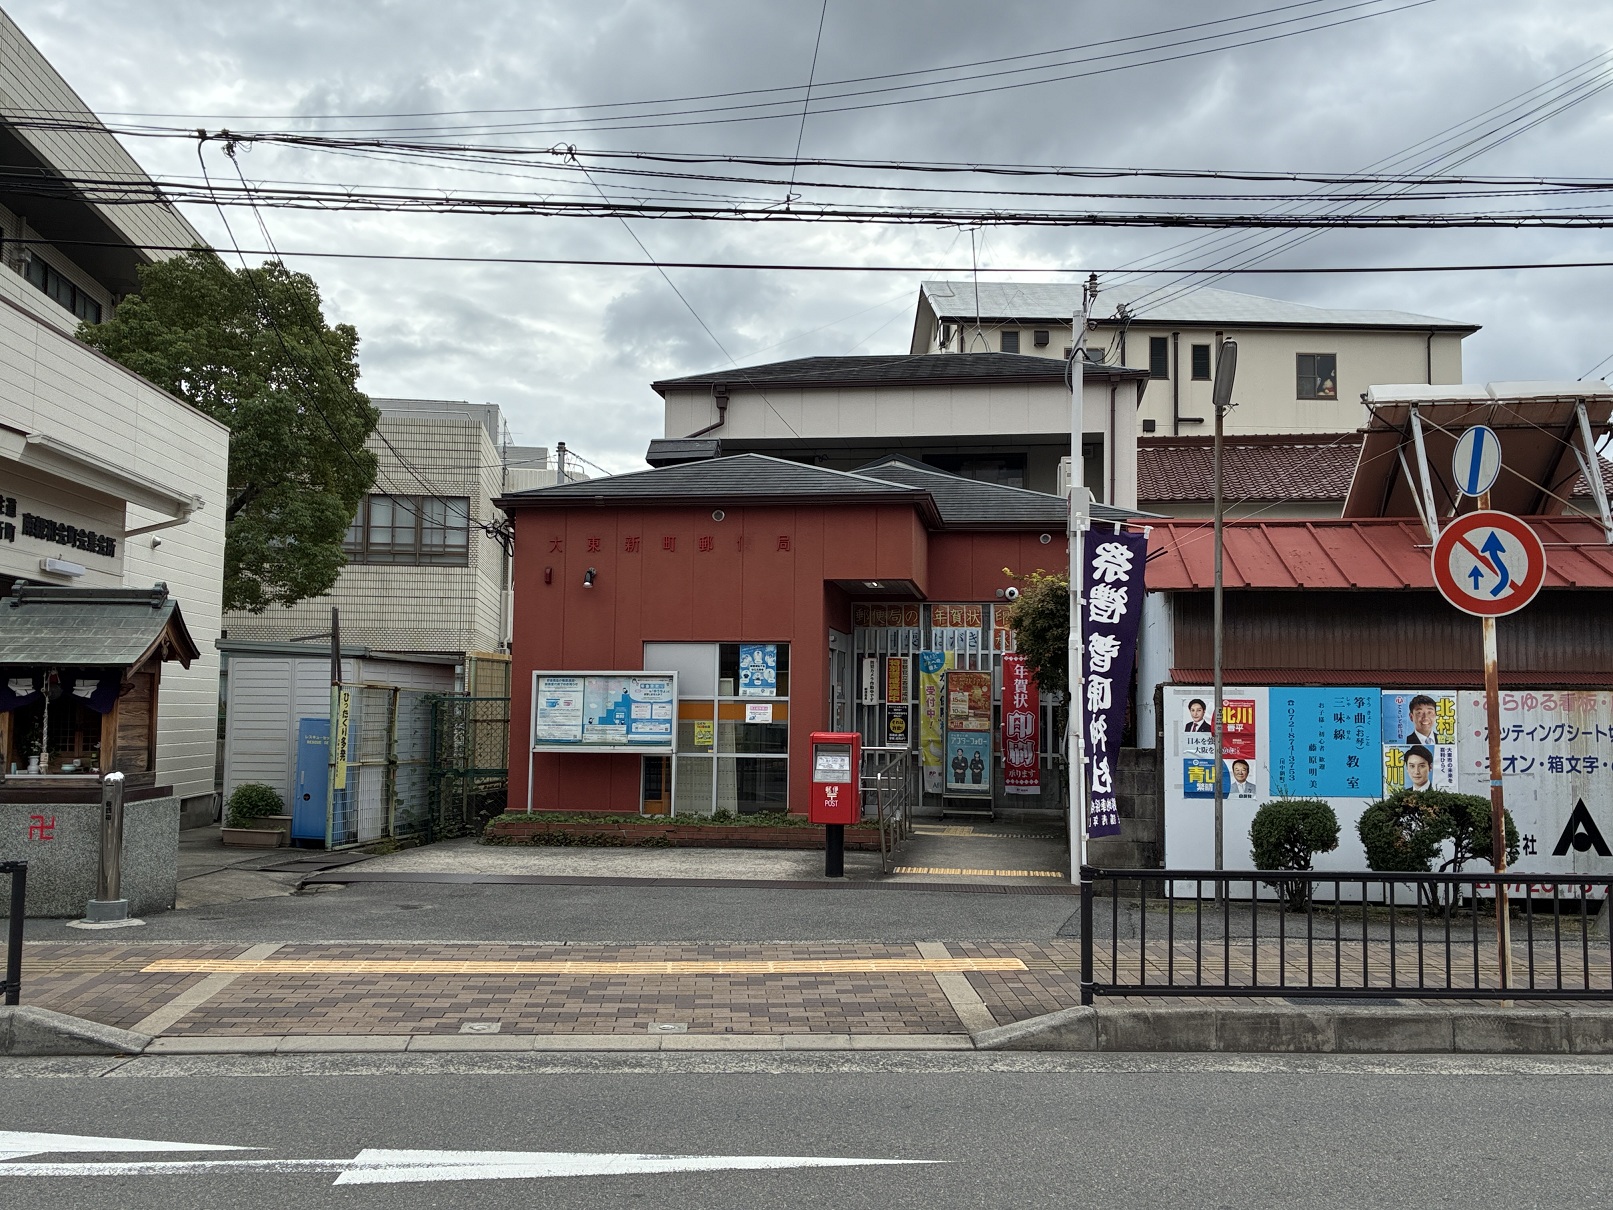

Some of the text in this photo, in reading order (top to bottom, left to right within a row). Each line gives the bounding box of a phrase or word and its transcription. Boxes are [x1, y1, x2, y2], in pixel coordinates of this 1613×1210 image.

[549, 535, 791, 553] 大東新町郵局
[855, 608, 918, 624] 郵便局の
[934, 608, 981, 624] 年賀状
[1014, 664, 1028, 708] 年賀状
[1222, 707, 1252, 724] 北川
[1333, 697, 1346, 741] 三味線
[1436, 697, 1456, 735] 北村
[1007, 710, 1035, 767] 印刷
[1308, 743, 1318, 789] 藤原明美
[1346, 754, 1360, 789] 教室
[1385, 747, 1405, 785] 北川
